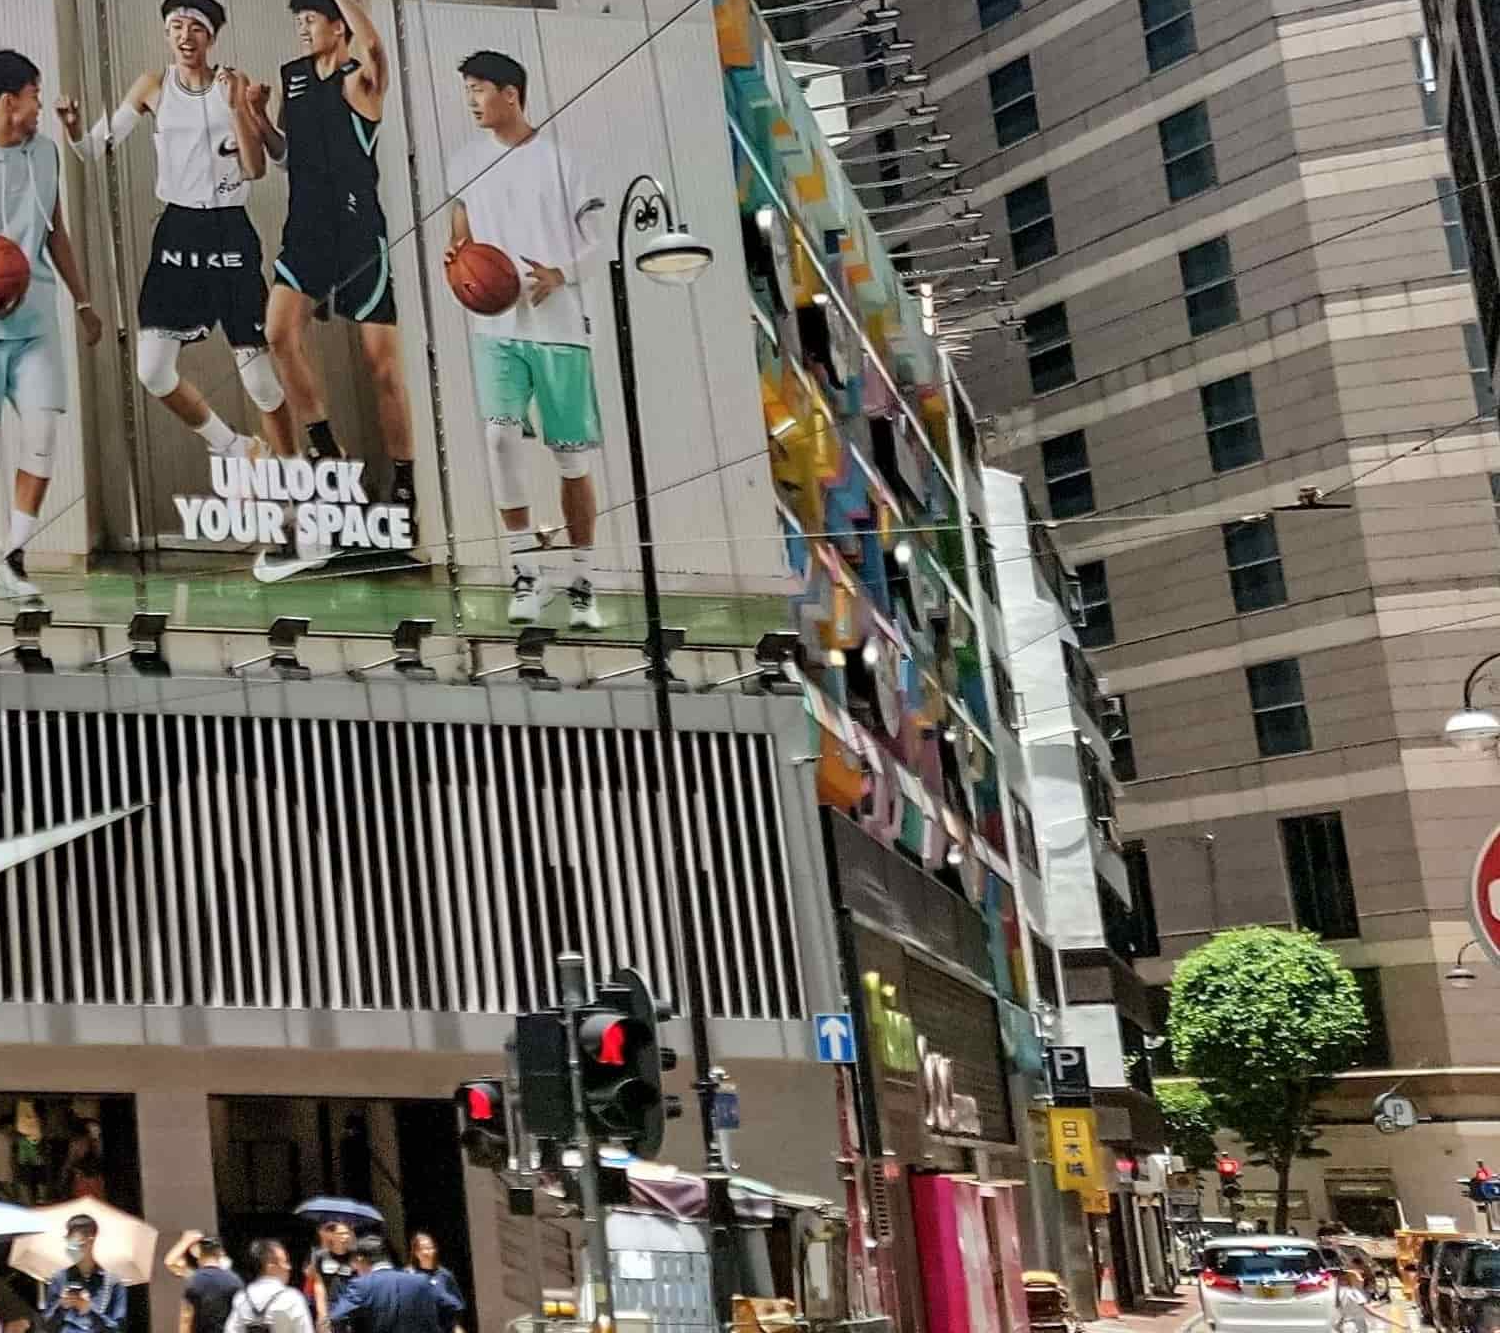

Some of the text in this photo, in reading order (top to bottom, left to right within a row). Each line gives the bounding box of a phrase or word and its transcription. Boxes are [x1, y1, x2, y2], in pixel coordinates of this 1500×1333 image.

[160, 248, 244, 269] NIKE
[209, 455, 369, 504] UNLOCK
[173, 497, 413, 550] YOUR SPACE
[1051, 1048, 1079, 1080] P
